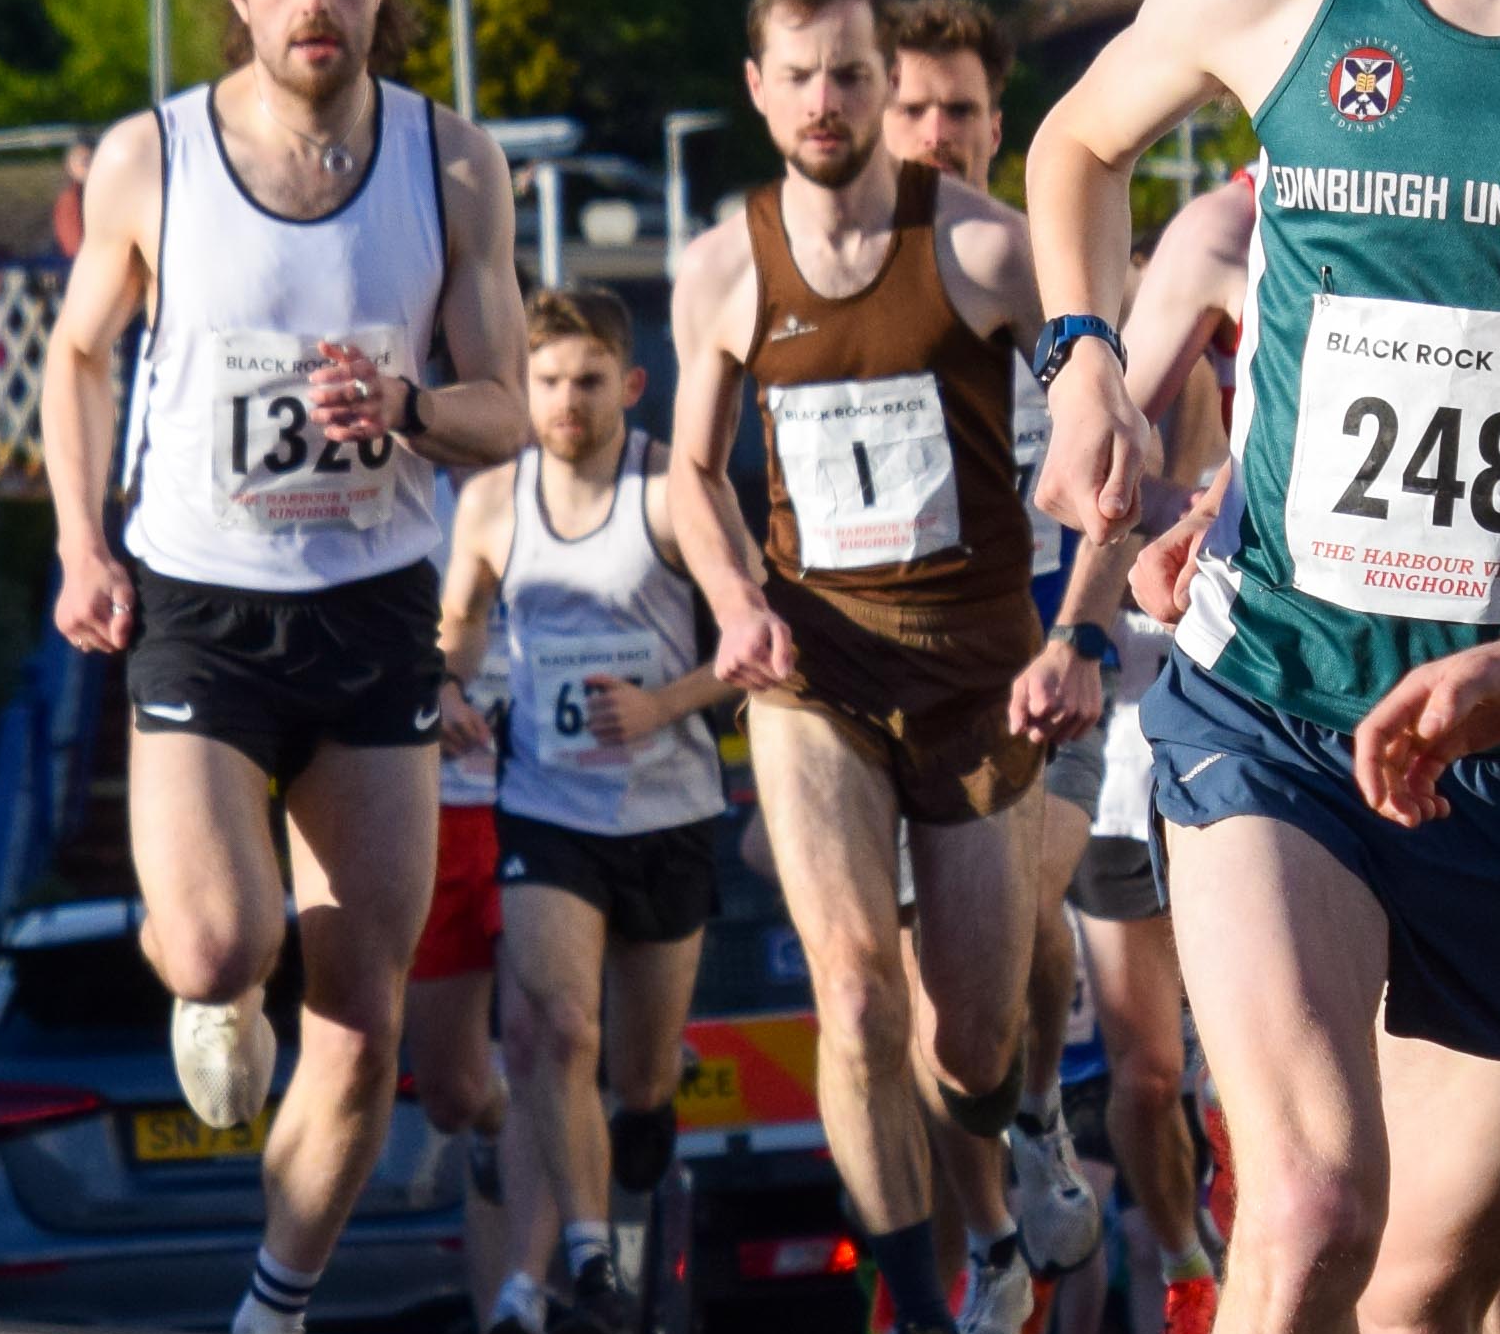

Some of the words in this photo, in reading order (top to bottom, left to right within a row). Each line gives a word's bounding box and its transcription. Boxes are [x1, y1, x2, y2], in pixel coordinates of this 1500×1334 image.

[1271, 165, 1449, 220] EDINBURGH
[226, 355, 286, 373] BLACK
[1325, 331, 1408, 363] BLACK
[1416, 343, 1493, 373] ROCK
[834, 404, 879, 419] ROCK
[883, 398, 928, 415] RACE
[852, 440, 877, 509] 1
[1311, 540, 1356, 562] THE
[1362, 547, 1474, 576] HARBOUR
[1363, 569, 1488, 599] KINGHORN
